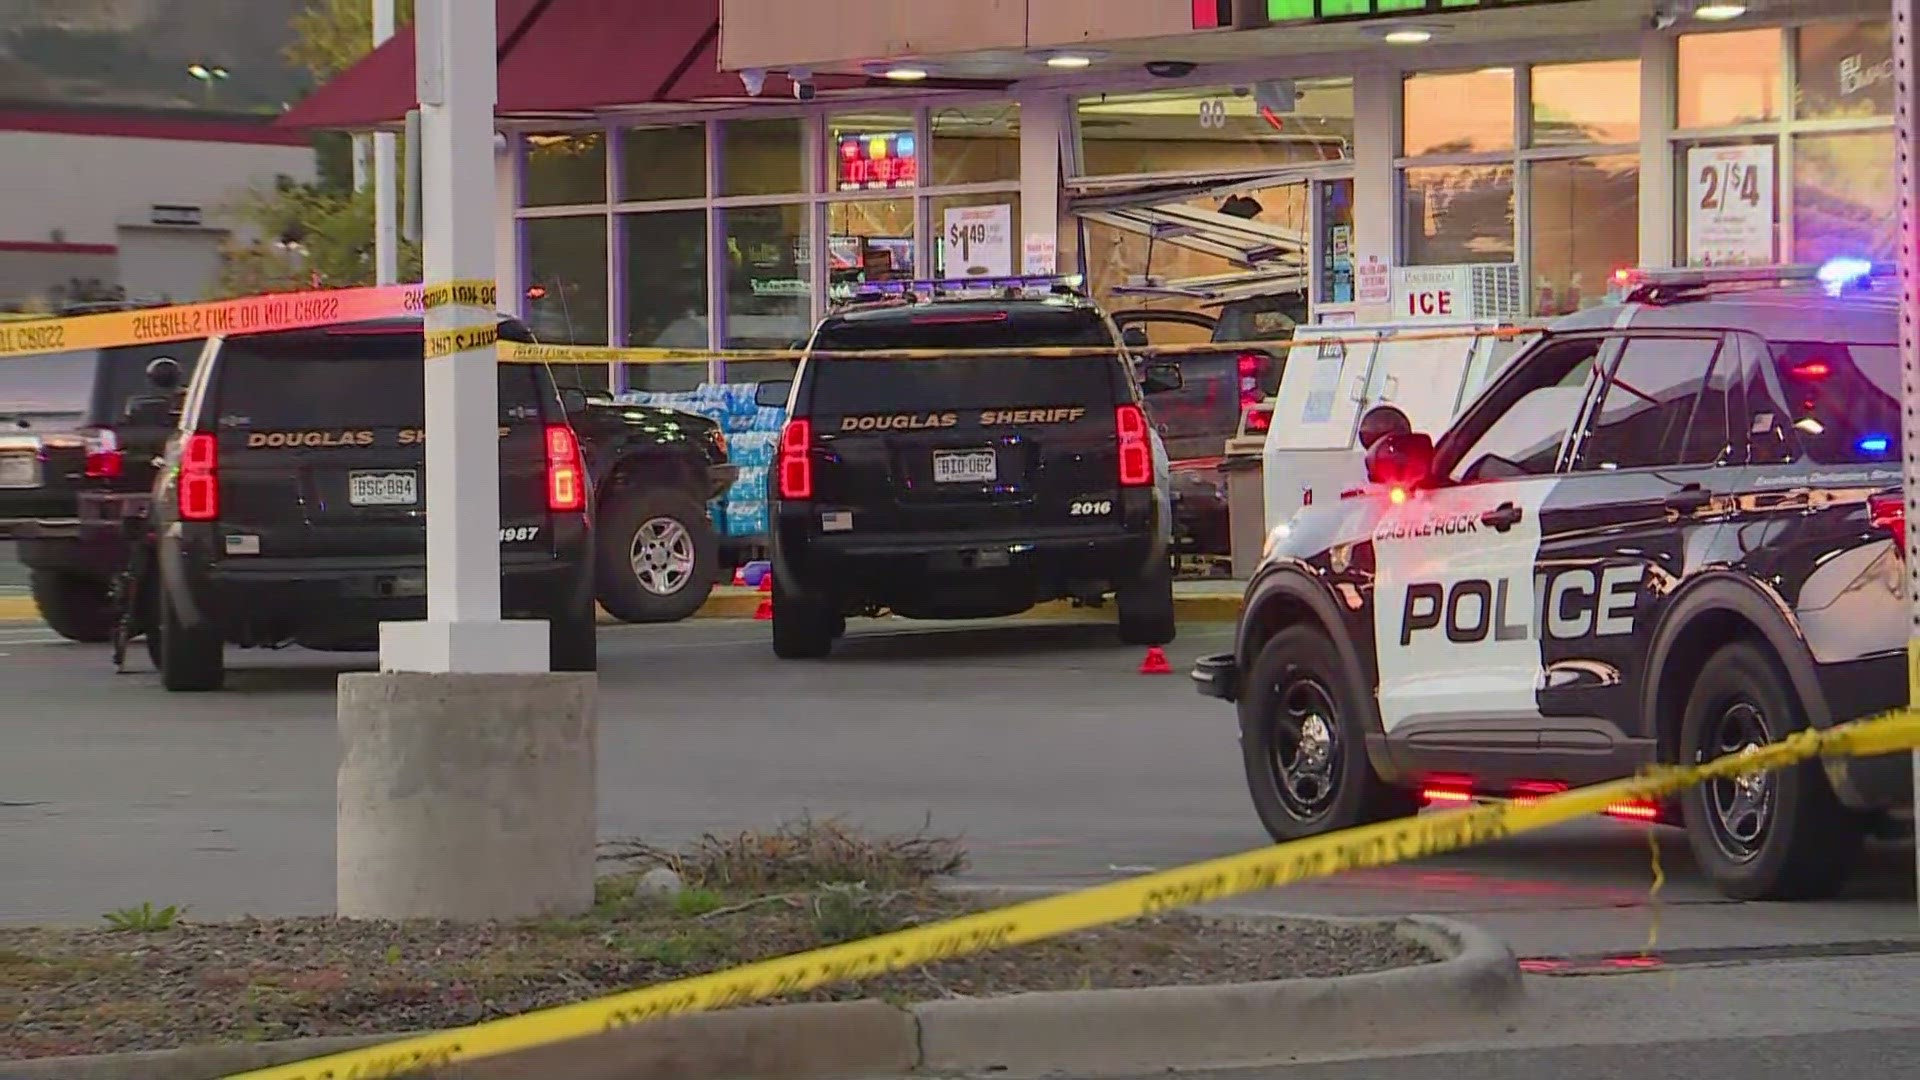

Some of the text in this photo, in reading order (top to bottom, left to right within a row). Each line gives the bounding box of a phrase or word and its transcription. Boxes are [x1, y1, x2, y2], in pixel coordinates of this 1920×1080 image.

[1409, 290, 1452, 316] ICE
[840, 408, 1086, 430] DOUGLAS SHERIFF
[249, 430, 374, 447] DOUGLAS
[1071, 501, 1112, 515] 2016
[498, 527, 539, 541] 1987
[1434, 513, 1481, 537] ROCK
[1400, 564, 1645, 646] POLICE
